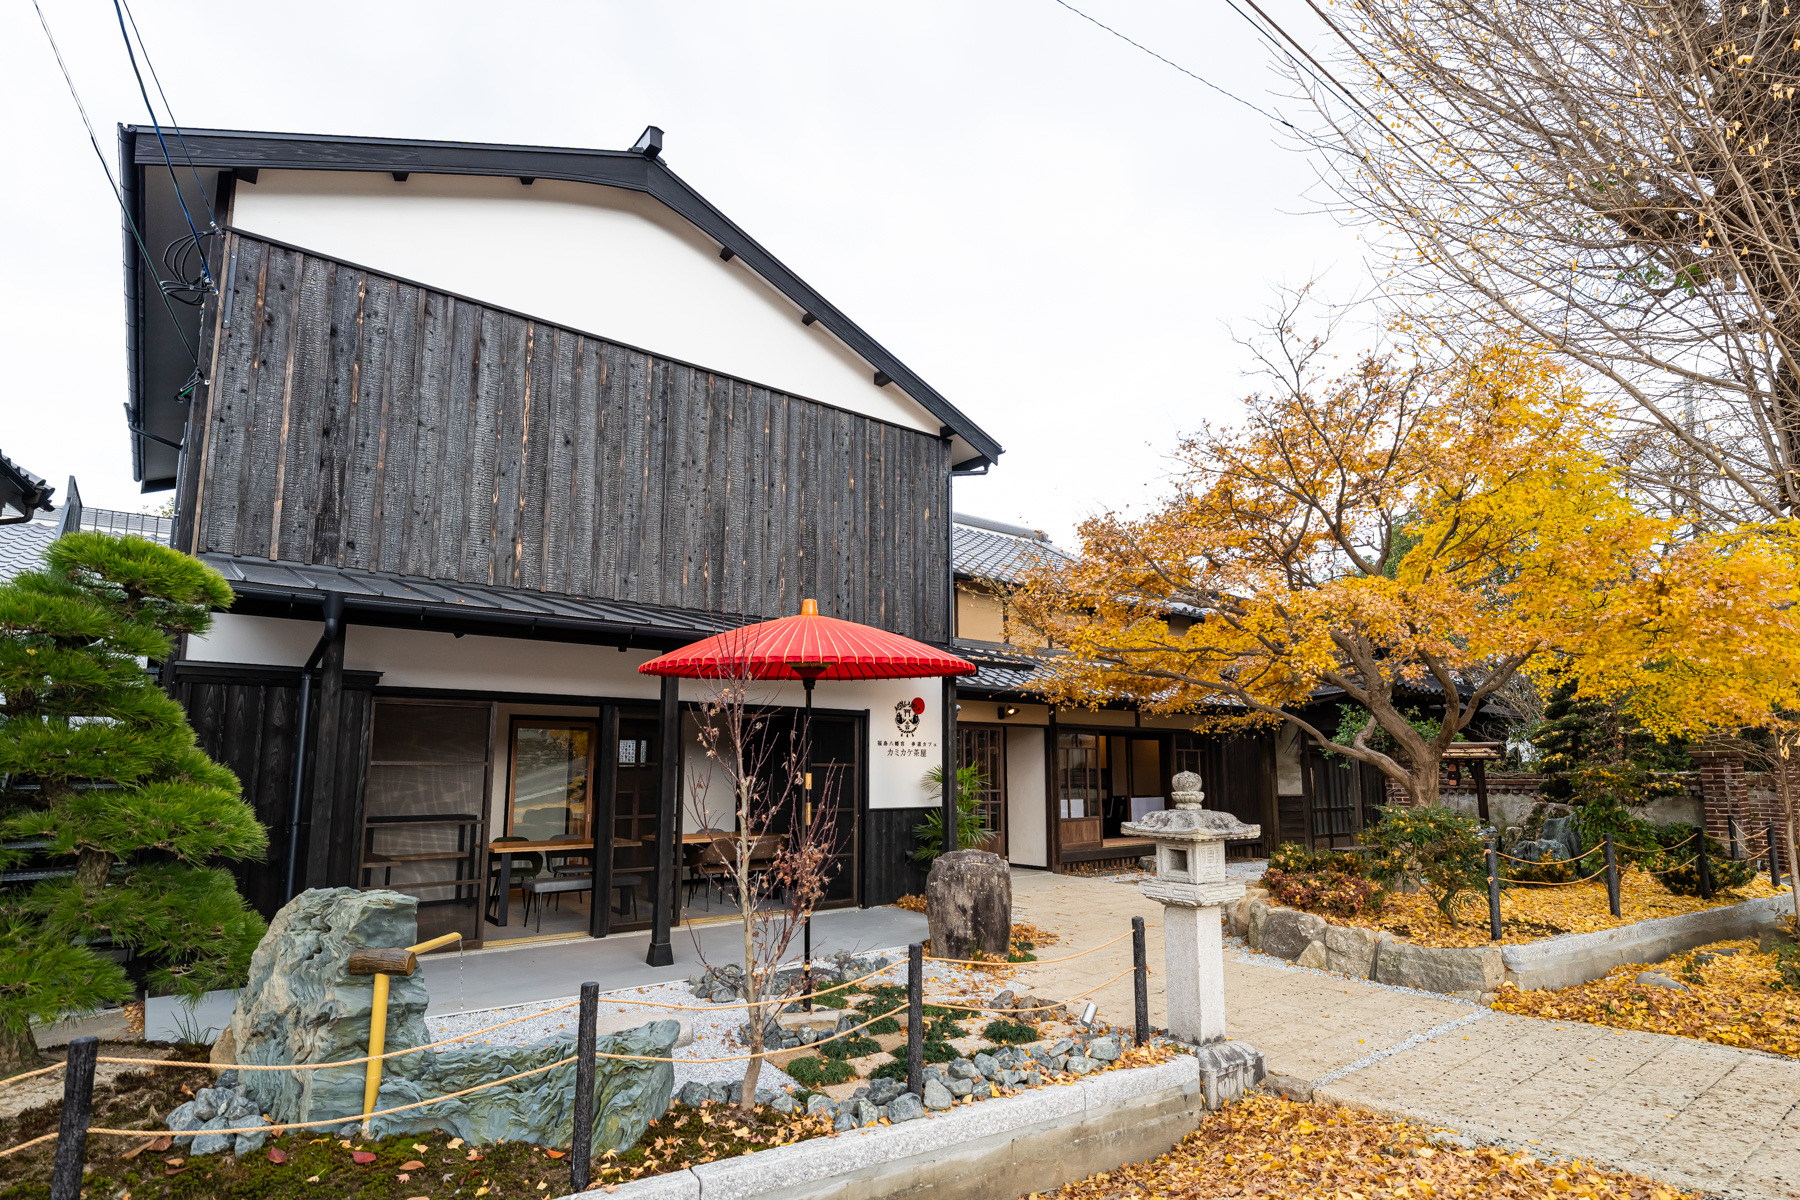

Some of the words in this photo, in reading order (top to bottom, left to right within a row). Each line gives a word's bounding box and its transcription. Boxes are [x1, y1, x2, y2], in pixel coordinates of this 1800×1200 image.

[887, 748, 927, 757] カミカケ茶屋
